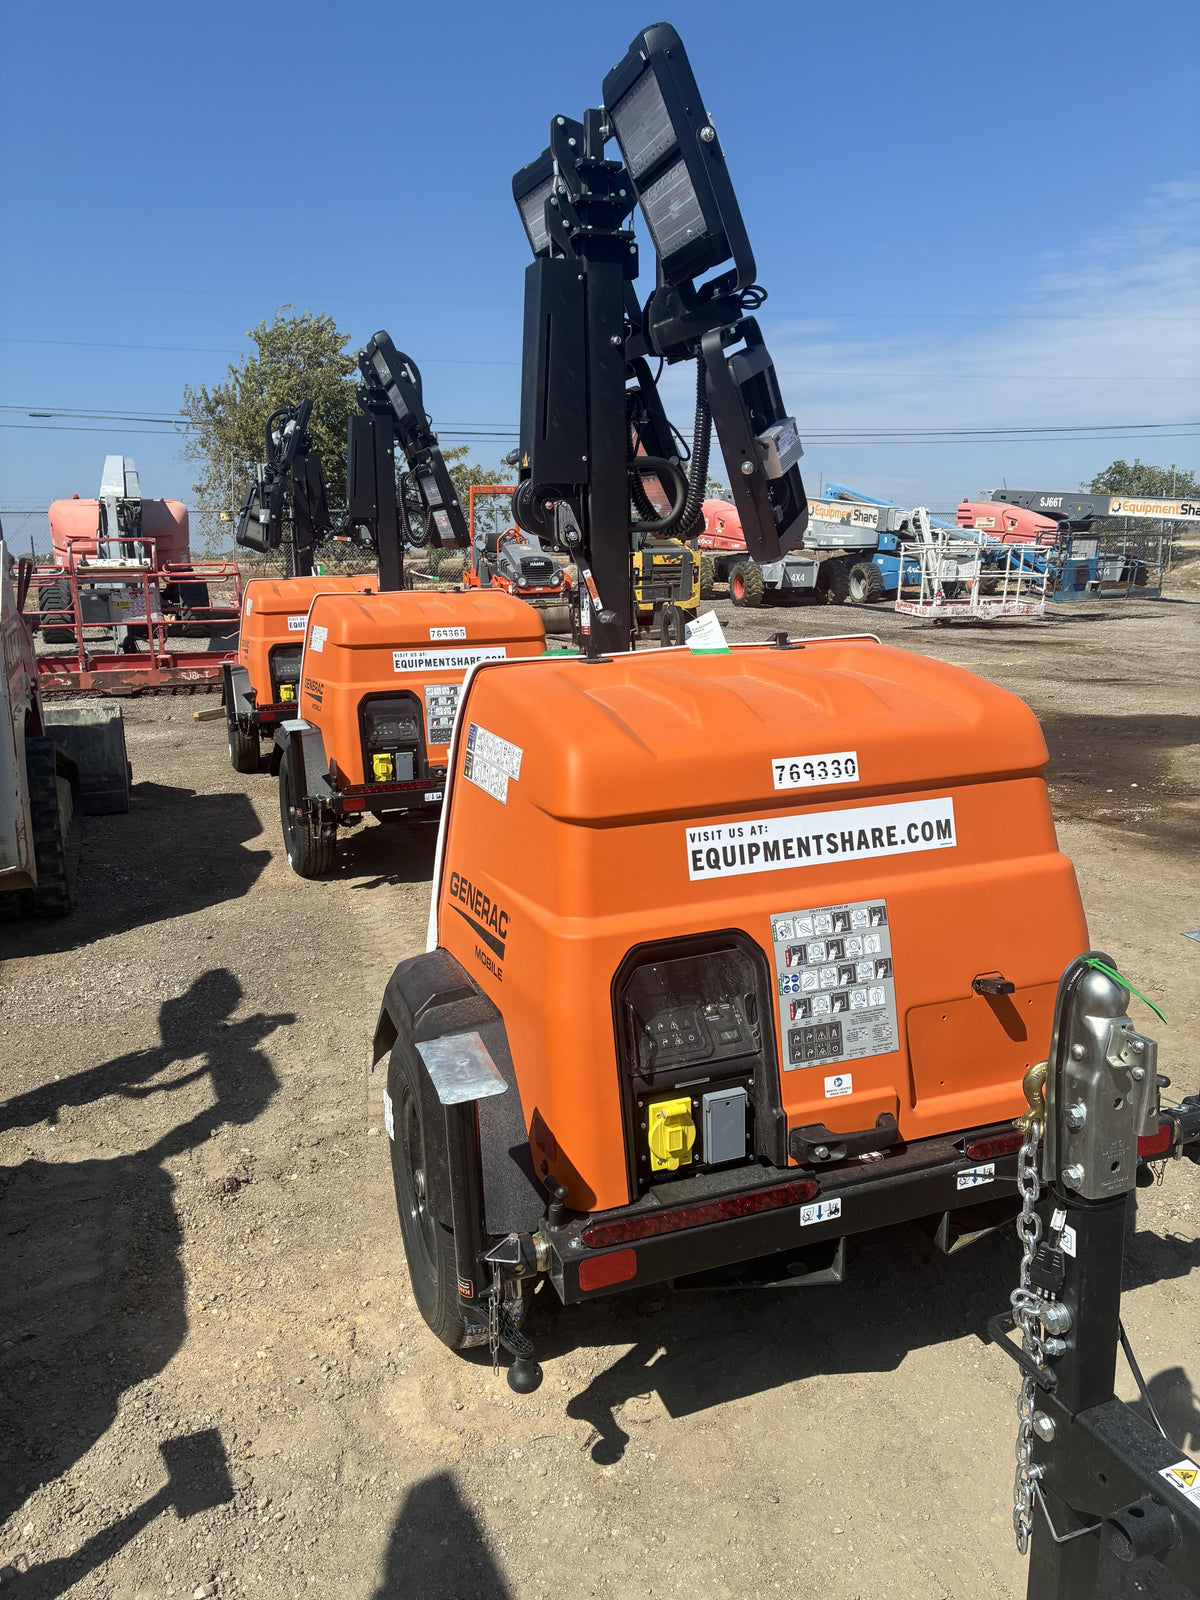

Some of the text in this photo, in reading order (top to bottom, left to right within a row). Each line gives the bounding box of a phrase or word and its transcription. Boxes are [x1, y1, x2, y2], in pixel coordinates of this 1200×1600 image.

[1040, 496, 1063, 508] SJ66T
[791, 573, 805, 582] 4X4
[289, 621, 306, 629] EQUI
[431, 629, 465, 638] 769365
[395, 655, 505, 669] EQUIPMENTSHARE
[775, 758, 856, 784] 769330
[689, 824, 768, 843] VISIT US AT:
[691, 818, 953, 872] EQUIPMENTSHARE.COM
[449, 871, 509, 940] GENERAC
[474, 944, 503, 982] MOBILE
